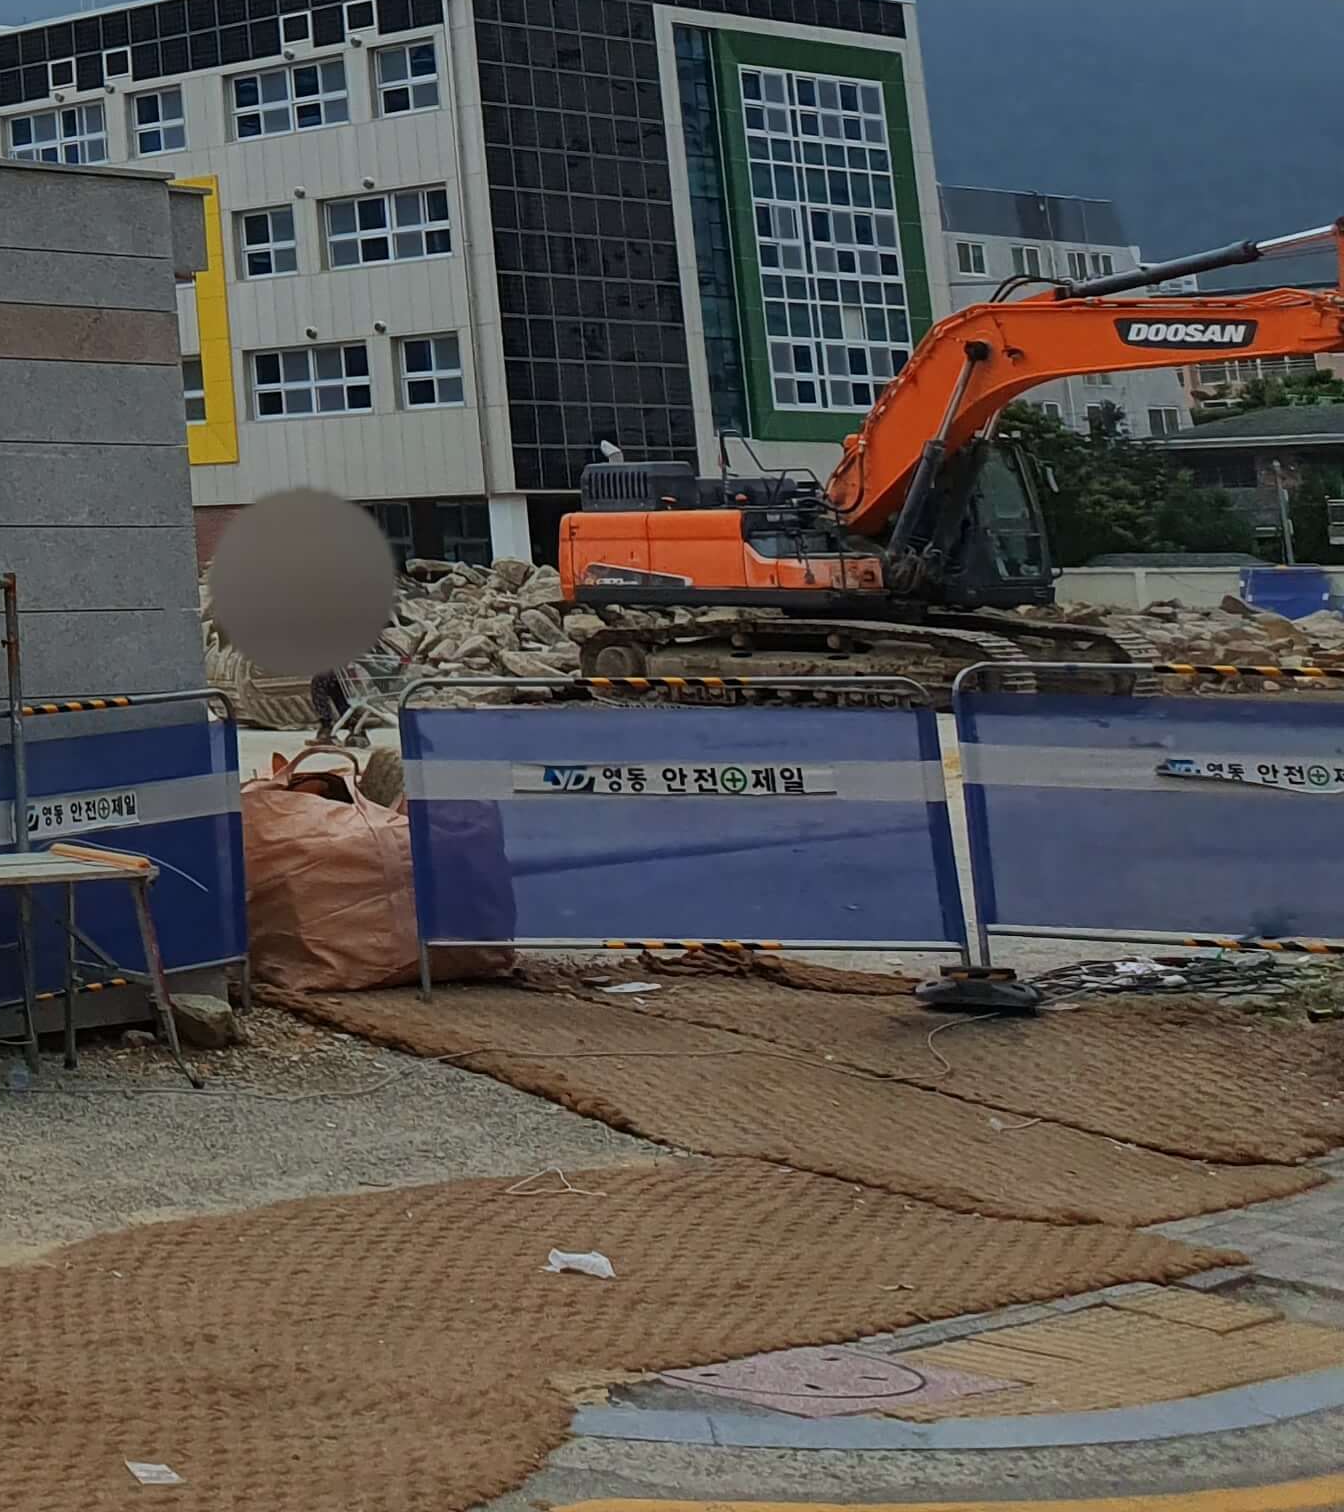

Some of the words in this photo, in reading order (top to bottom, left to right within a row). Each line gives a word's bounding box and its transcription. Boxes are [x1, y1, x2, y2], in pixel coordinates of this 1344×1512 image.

[1127, 323, 1246, 343] DOOSAN
[602, 767, 647, 792] 영동
[662, 767, 718, 793] 안전
[751, 767, 805, 793] 제일
[1257, 764, 1306, 785] 안전
[42, 804, 64, 826] 영동
[70, 800, 97, 822] 안전
[111, 793, 136, 816] 제일
